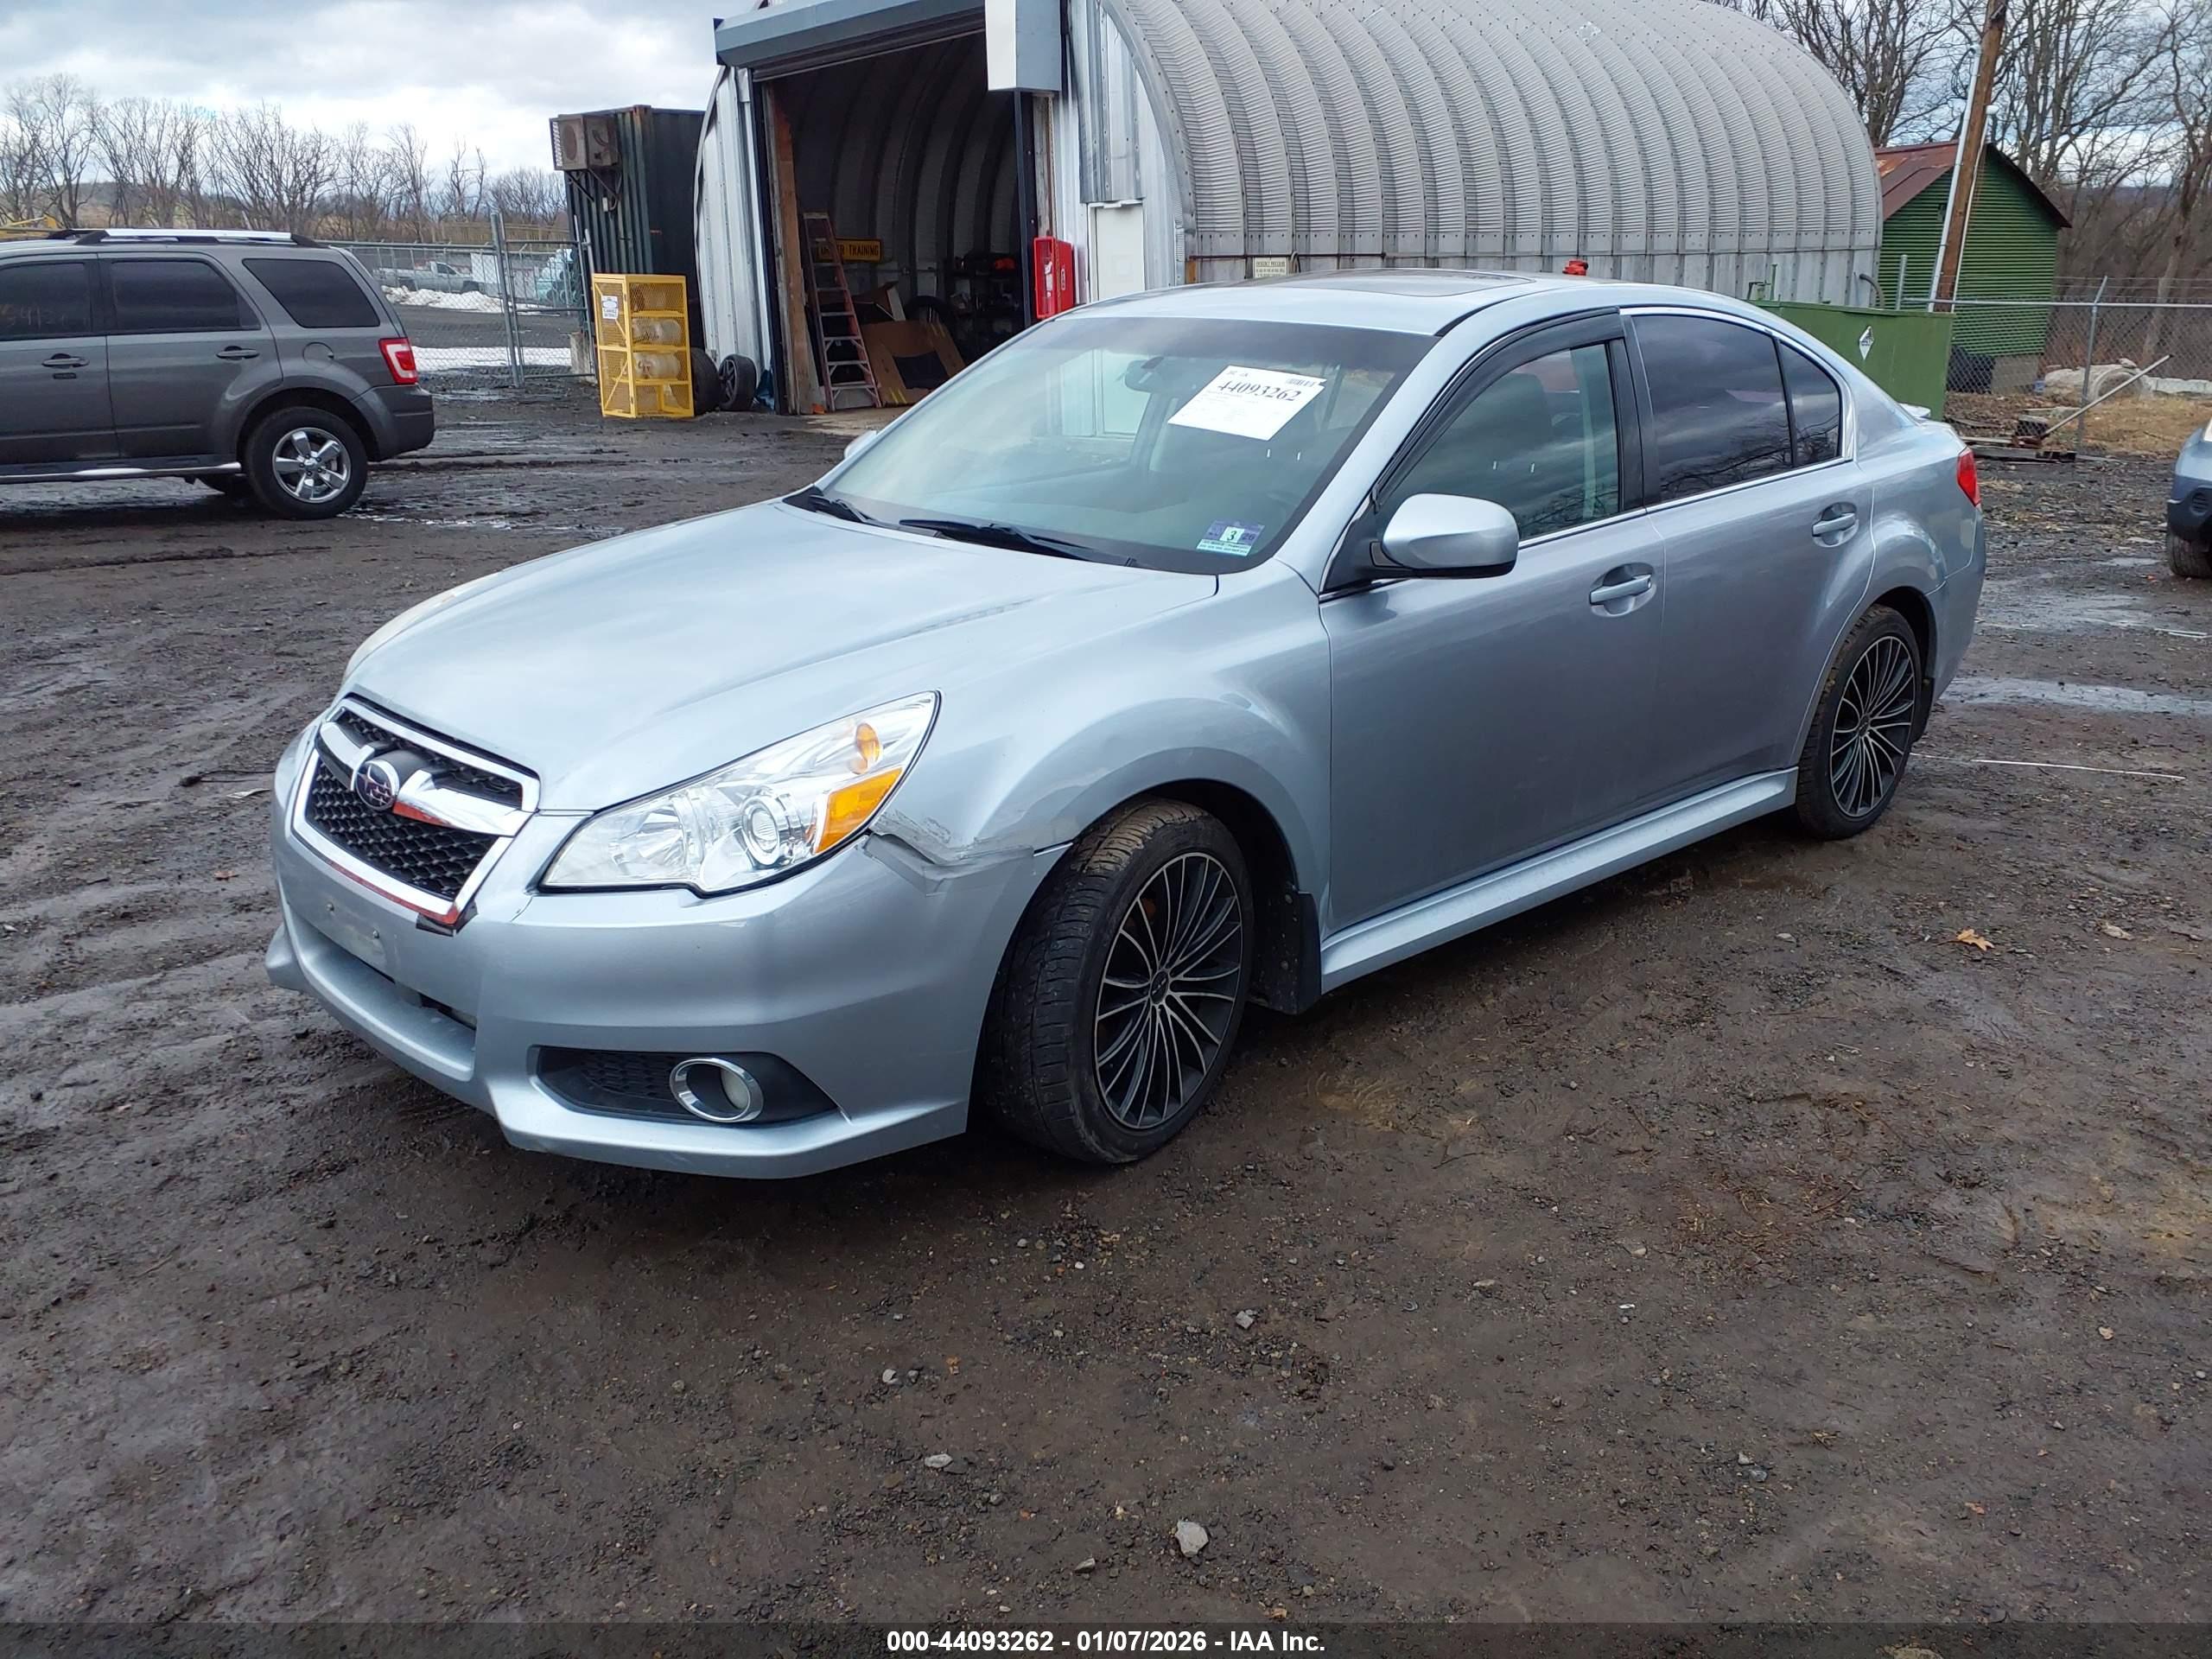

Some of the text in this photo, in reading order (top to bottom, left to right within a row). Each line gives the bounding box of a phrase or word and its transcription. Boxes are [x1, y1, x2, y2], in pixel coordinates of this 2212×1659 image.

[849, 244, 879, 257] TRAINING
[1217, 380, 1301, 401] 44093262
[1227, 530, 1237, 541] 3
